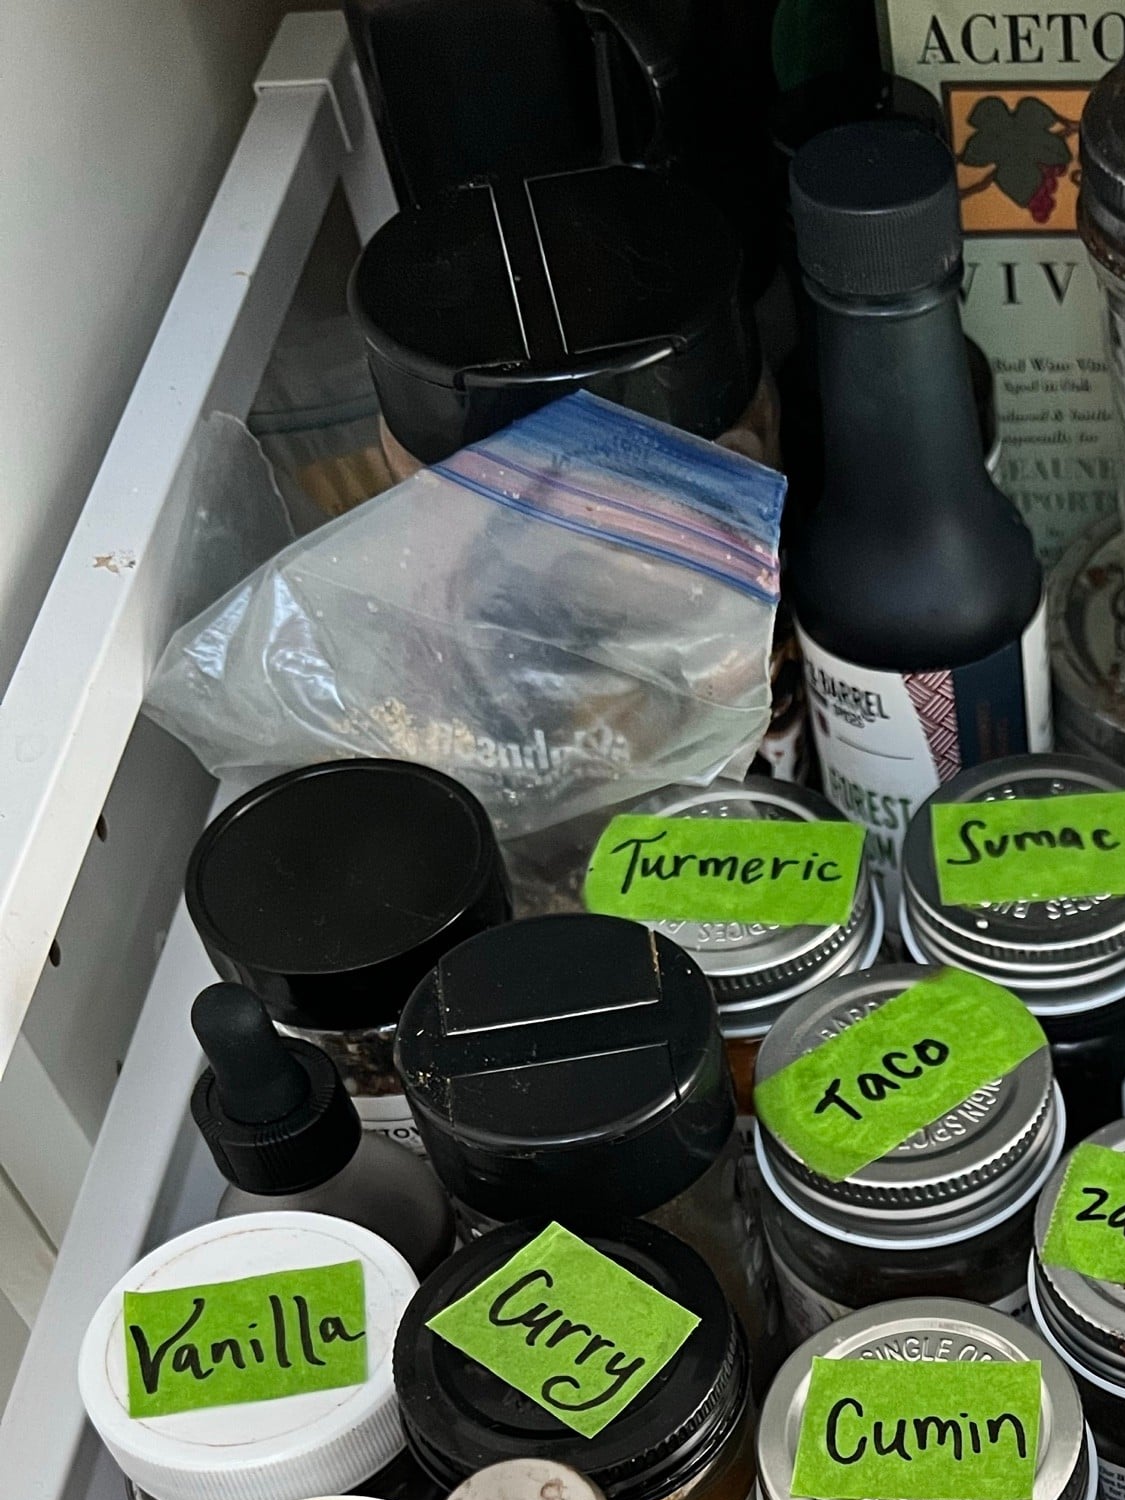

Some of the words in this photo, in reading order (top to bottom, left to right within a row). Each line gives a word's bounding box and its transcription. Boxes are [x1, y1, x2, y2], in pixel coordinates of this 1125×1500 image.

[610, 830, 844, 895] Turmeric
[946, 820, 1121, 866] Sumac
[129, 1294, 366, 1395] Vanilla
[488, 1269, 646, 1412] Curry
[825, 1397, 1027, 1465] Cumin
